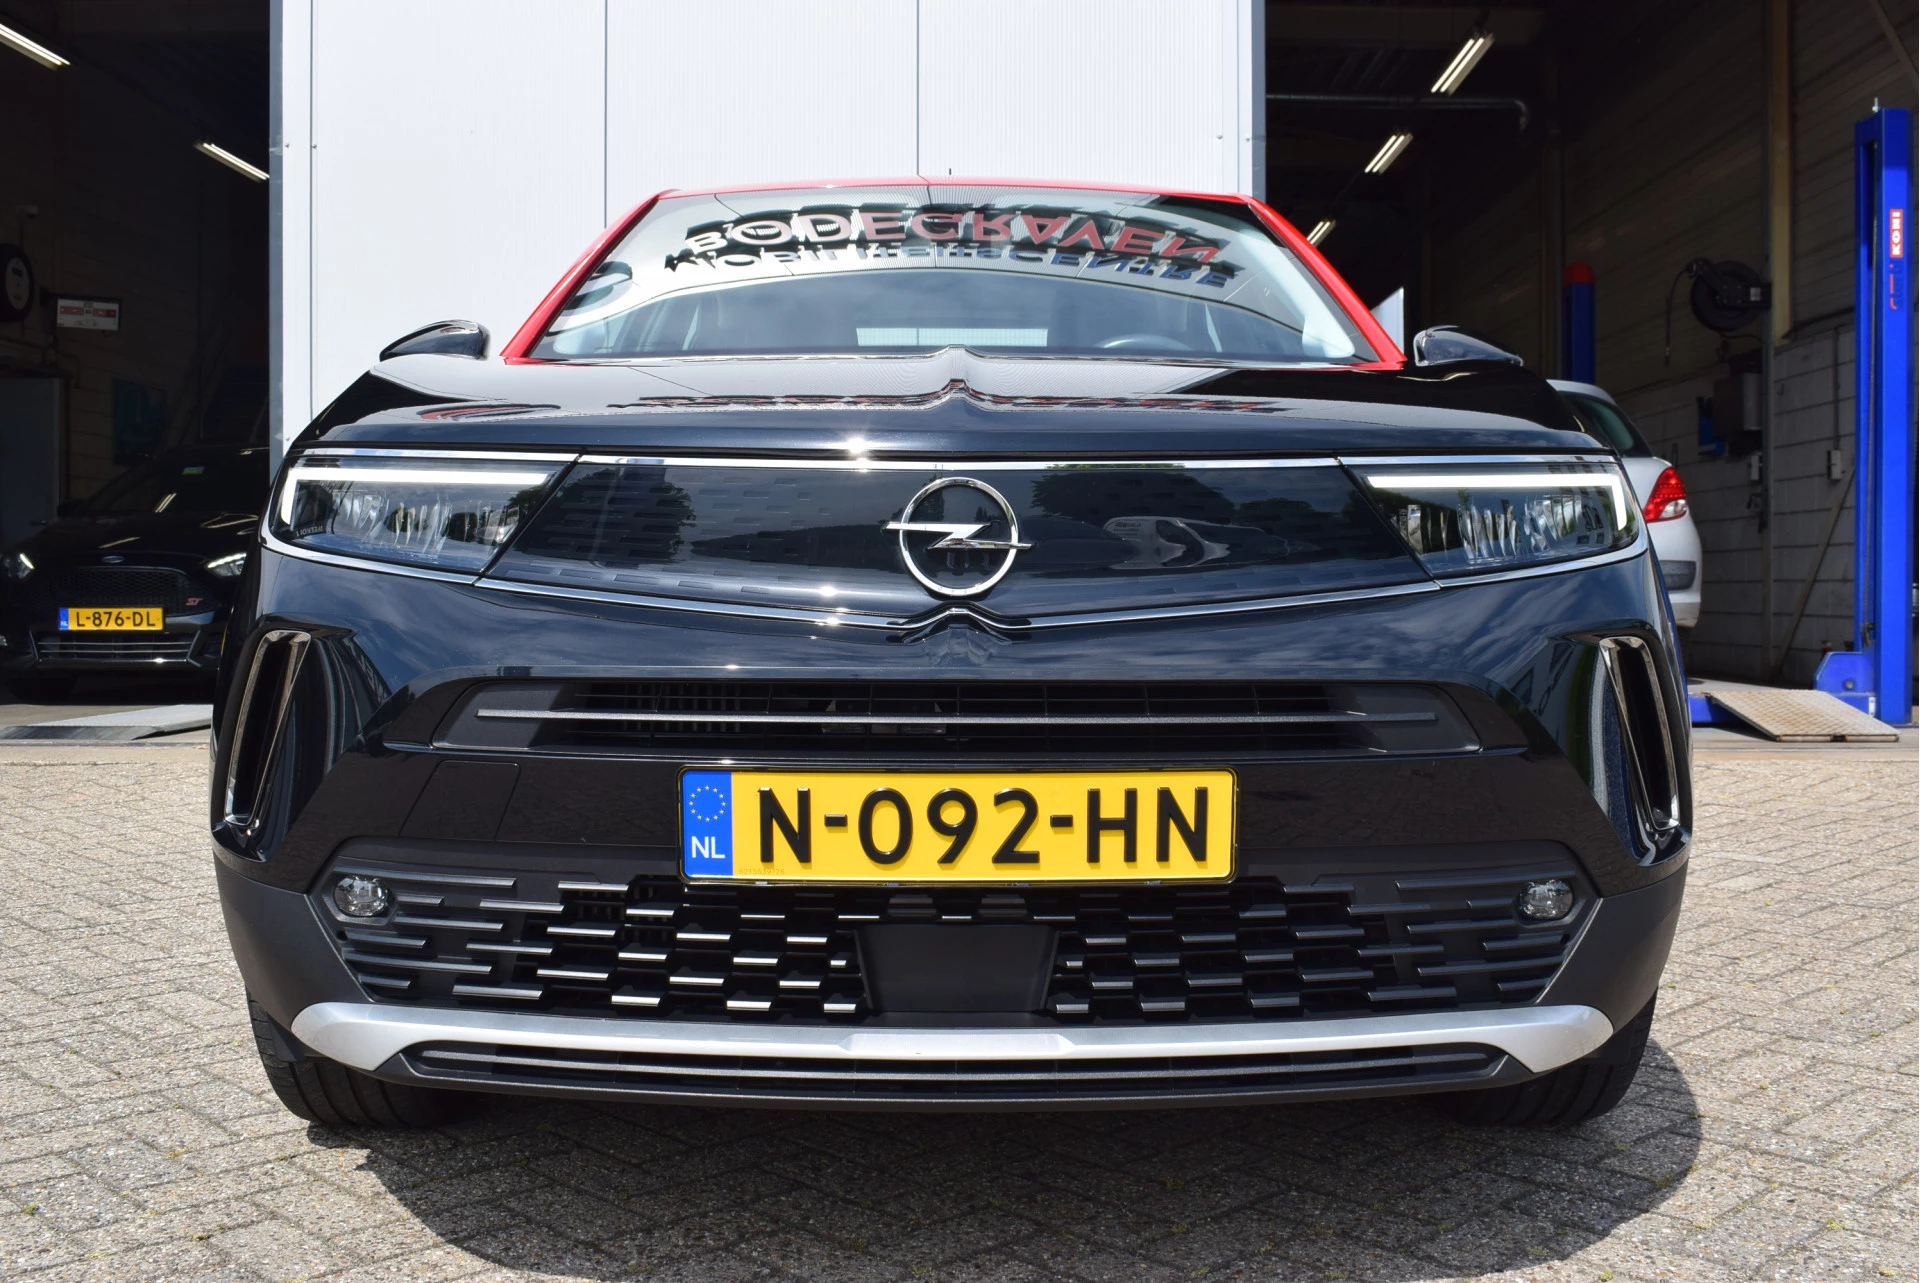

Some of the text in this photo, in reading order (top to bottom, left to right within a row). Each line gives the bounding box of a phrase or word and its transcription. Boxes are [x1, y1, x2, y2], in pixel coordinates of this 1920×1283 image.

[1891, 211, 1901, 255] KONI
[185, 597, 203, 606] ST
[76, 611, 156, 627] L-876-DL
[757, 786, 1209, 865] N-092-HN
[690, 836, 726, 859] NL
